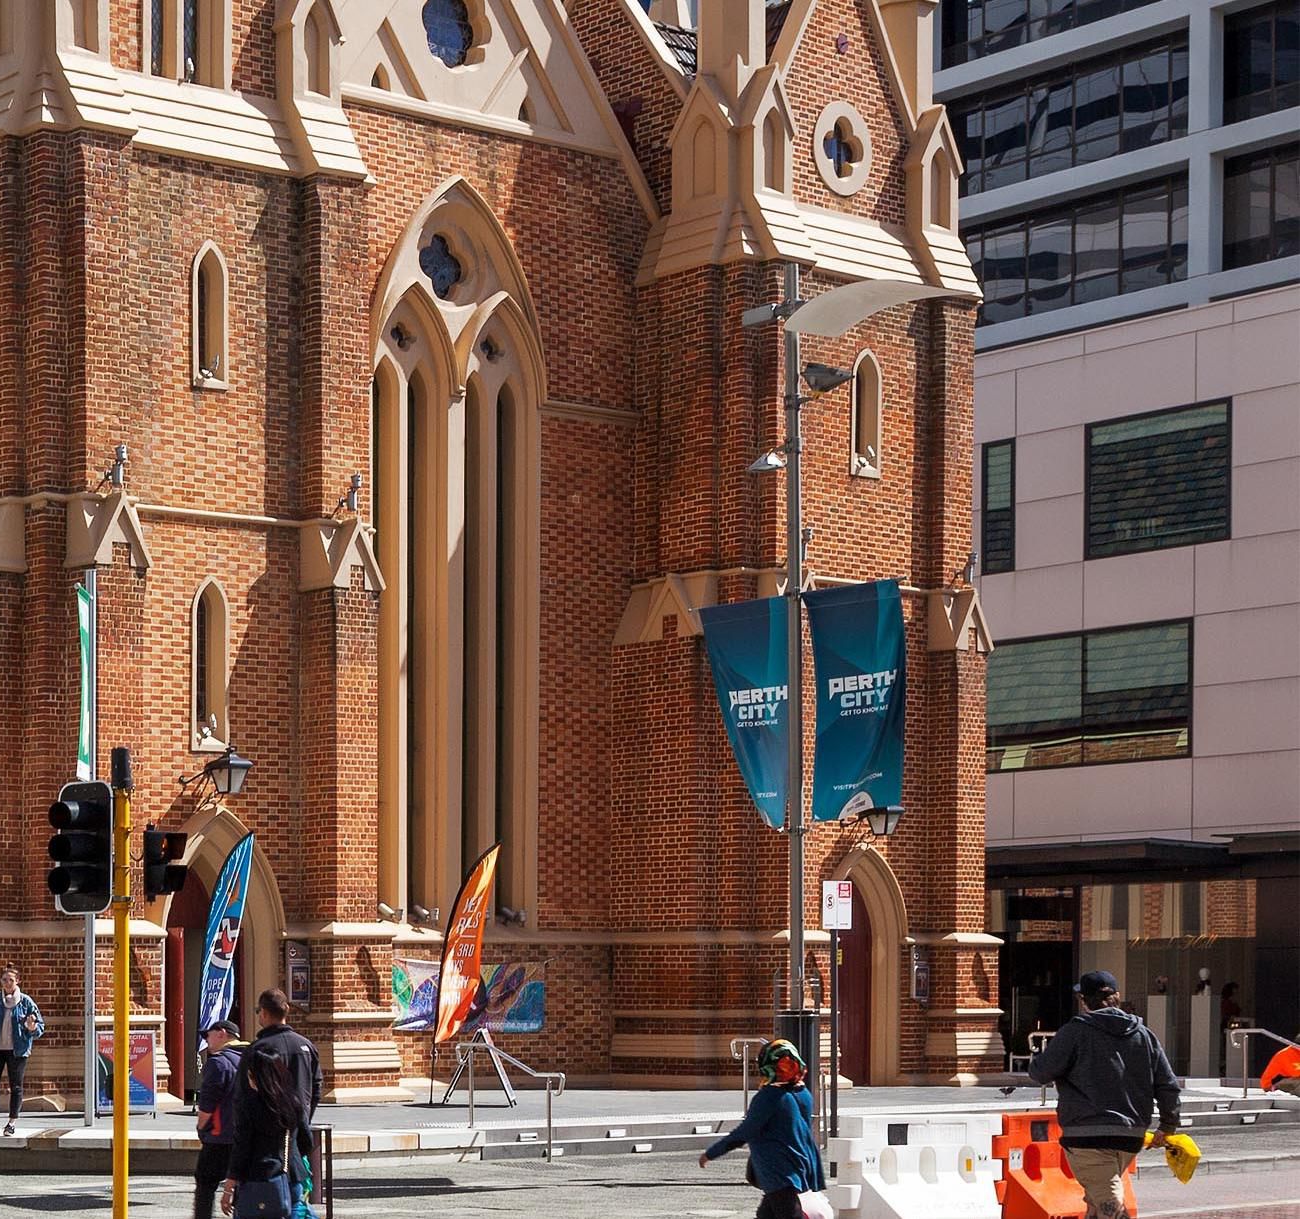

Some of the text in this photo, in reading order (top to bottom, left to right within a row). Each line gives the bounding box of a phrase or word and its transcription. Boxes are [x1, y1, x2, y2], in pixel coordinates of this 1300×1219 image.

[828, 668, 898, 700] PERTH
[728, 685, 789, 711] PERTH
[840, 688, 889, 709] CITY
[738, 702, 779, 720] CITY
[840, 709, 851, 717] GET
[457, 943, 476, 958] 3RD
[207, 977, 224, 991] OPE
